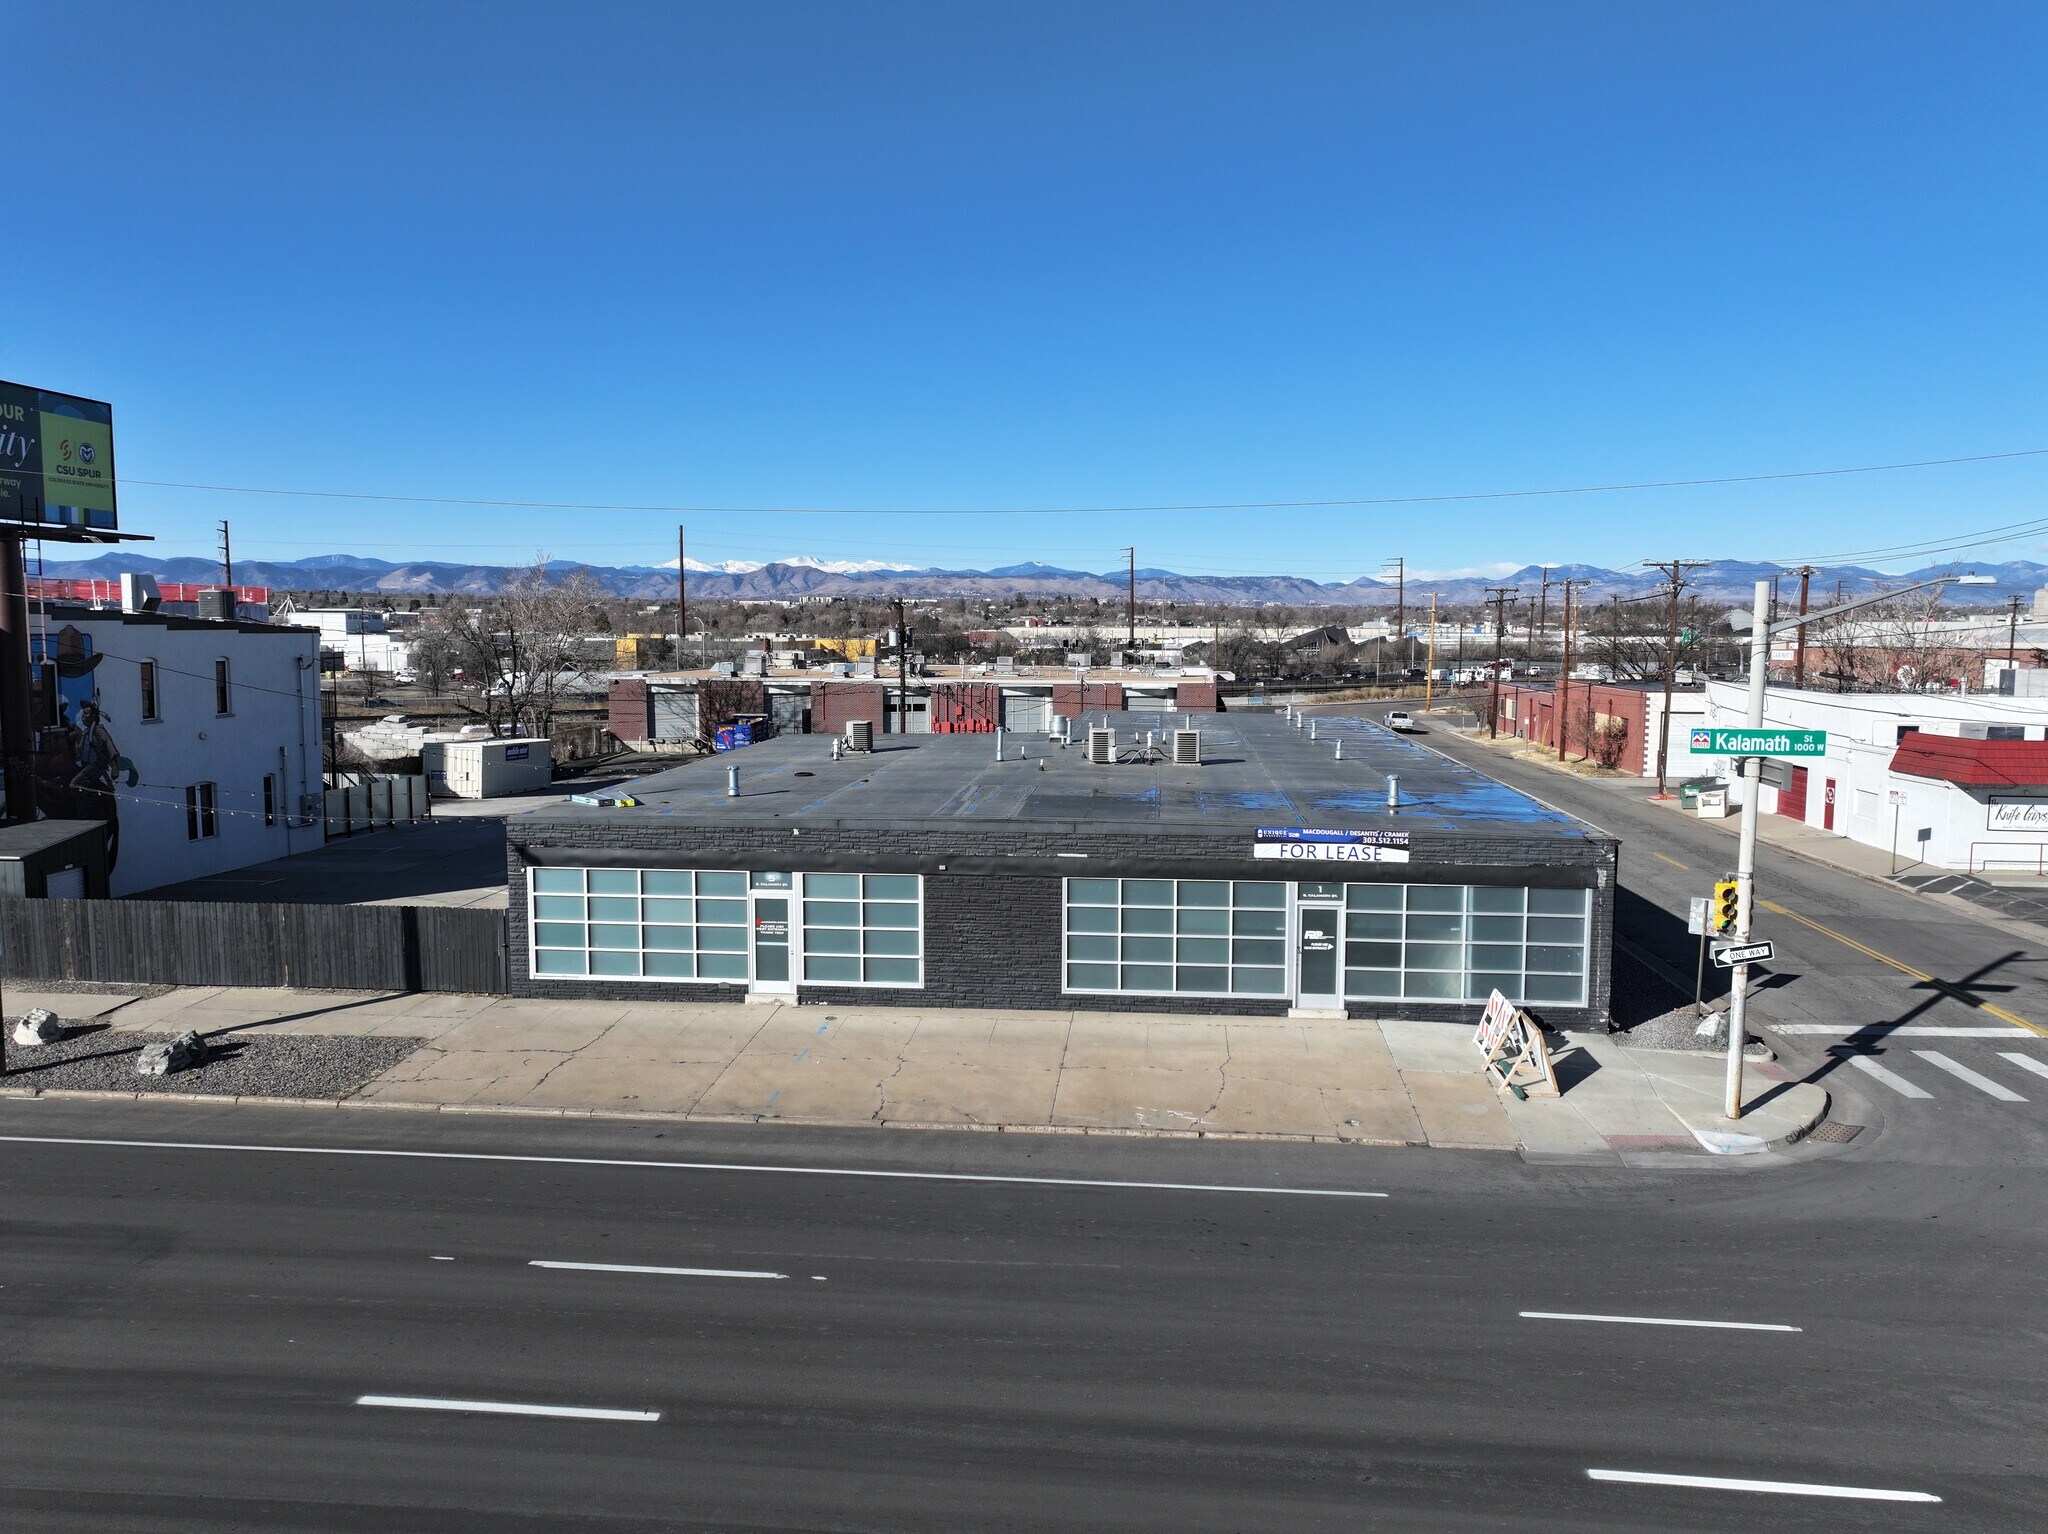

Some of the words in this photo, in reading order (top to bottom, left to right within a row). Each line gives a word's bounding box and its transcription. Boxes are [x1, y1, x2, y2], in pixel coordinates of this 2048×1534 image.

[56, 465, 75, 476] CSU
[77, 467, 101, 479] SPUR
[1716, 733, 1790, 752] Kalamath
[1804, 735, 1813, 743] St
[1794, 743, 1814, 752] 1000
[1817, 744, 1824, 752] W
[1995, 804, 2021, 825] Knife
[1362, 837, 1409, 845] 303.512.1154
[1280, 844, 1317, 859] FOR
[1326, 845, 1382, 861] LEASE
[1318, 885, 1323, 893] 1
[1730, 951, 1746, 960] ONE
[1749, 947, 1766, 957] WAY
